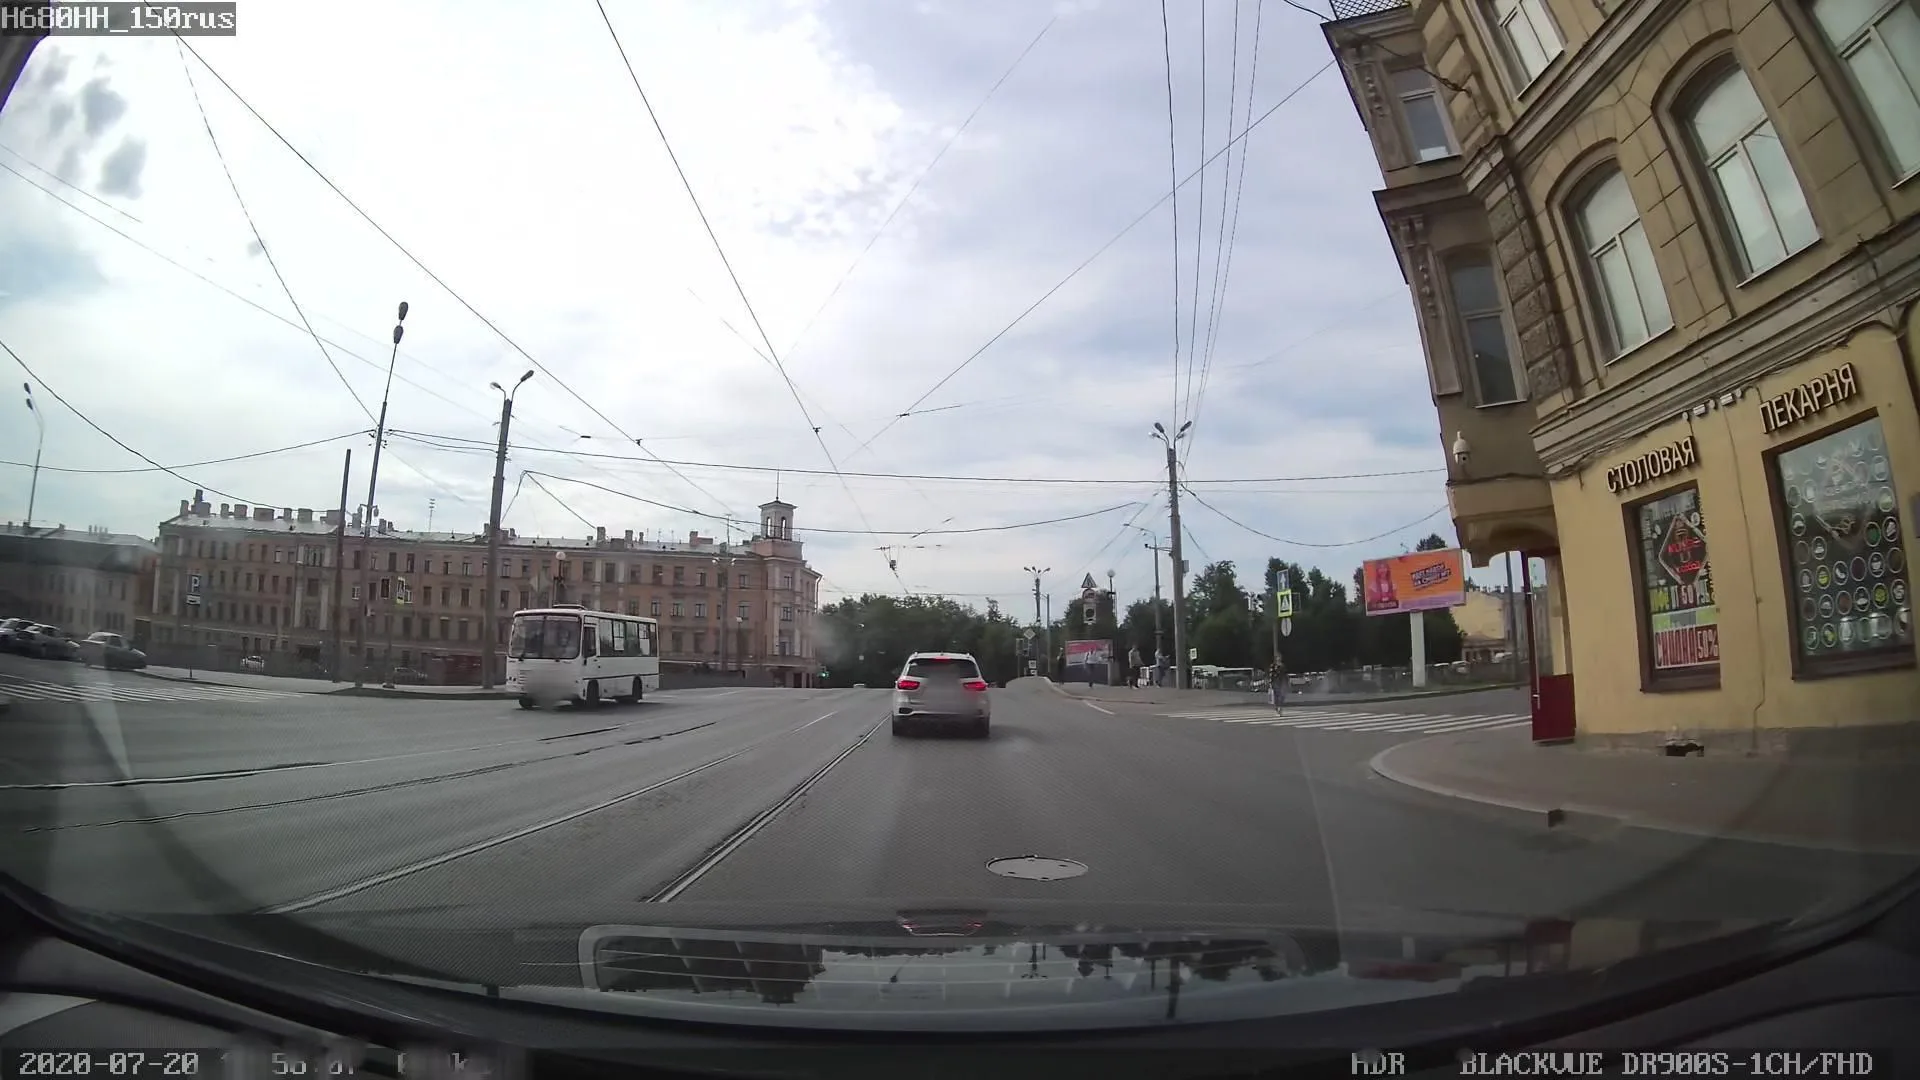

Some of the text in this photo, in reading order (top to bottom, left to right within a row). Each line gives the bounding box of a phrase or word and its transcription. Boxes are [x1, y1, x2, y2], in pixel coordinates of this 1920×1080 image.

[1759, 363, 1857, 434] ПЕКАРНЯ
[1607, 436, 1696, 493] СТОЛОВАЯ
[1697, 628, 1719, 659] 50%
